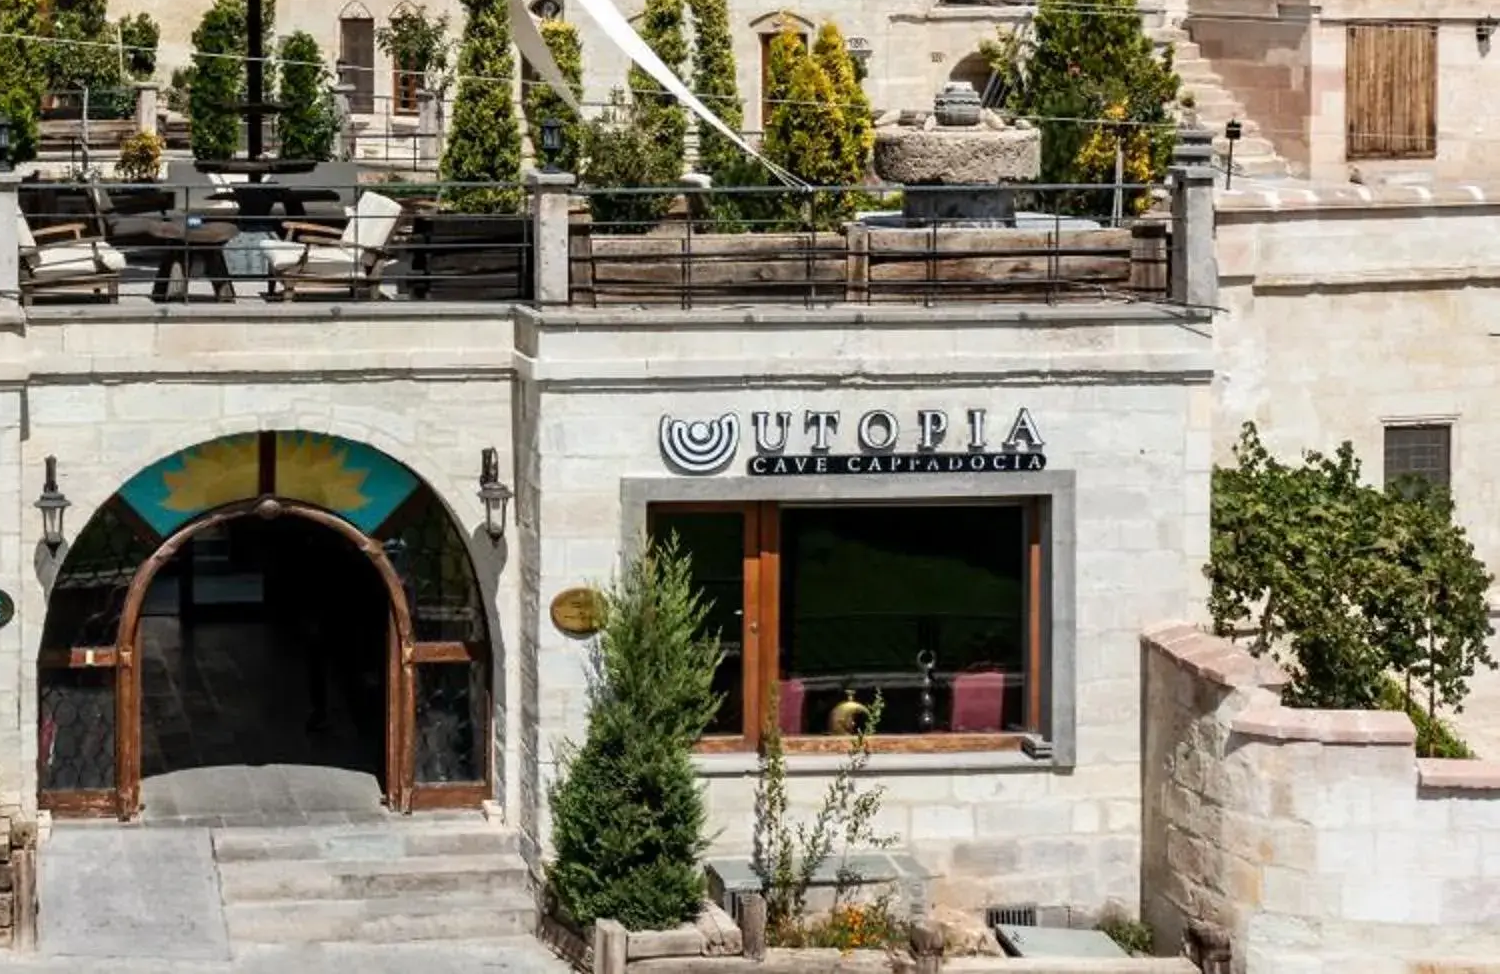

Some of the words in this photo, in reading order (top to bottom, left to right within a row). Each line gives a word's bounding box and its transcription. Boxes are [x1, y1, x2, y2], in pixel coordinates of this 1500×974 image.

[753, 407, 1046, 452] UTOPIA
[752, 456, 828, 473] CAVE
[846, 455, 1042, 472] CAPPADOCIA
